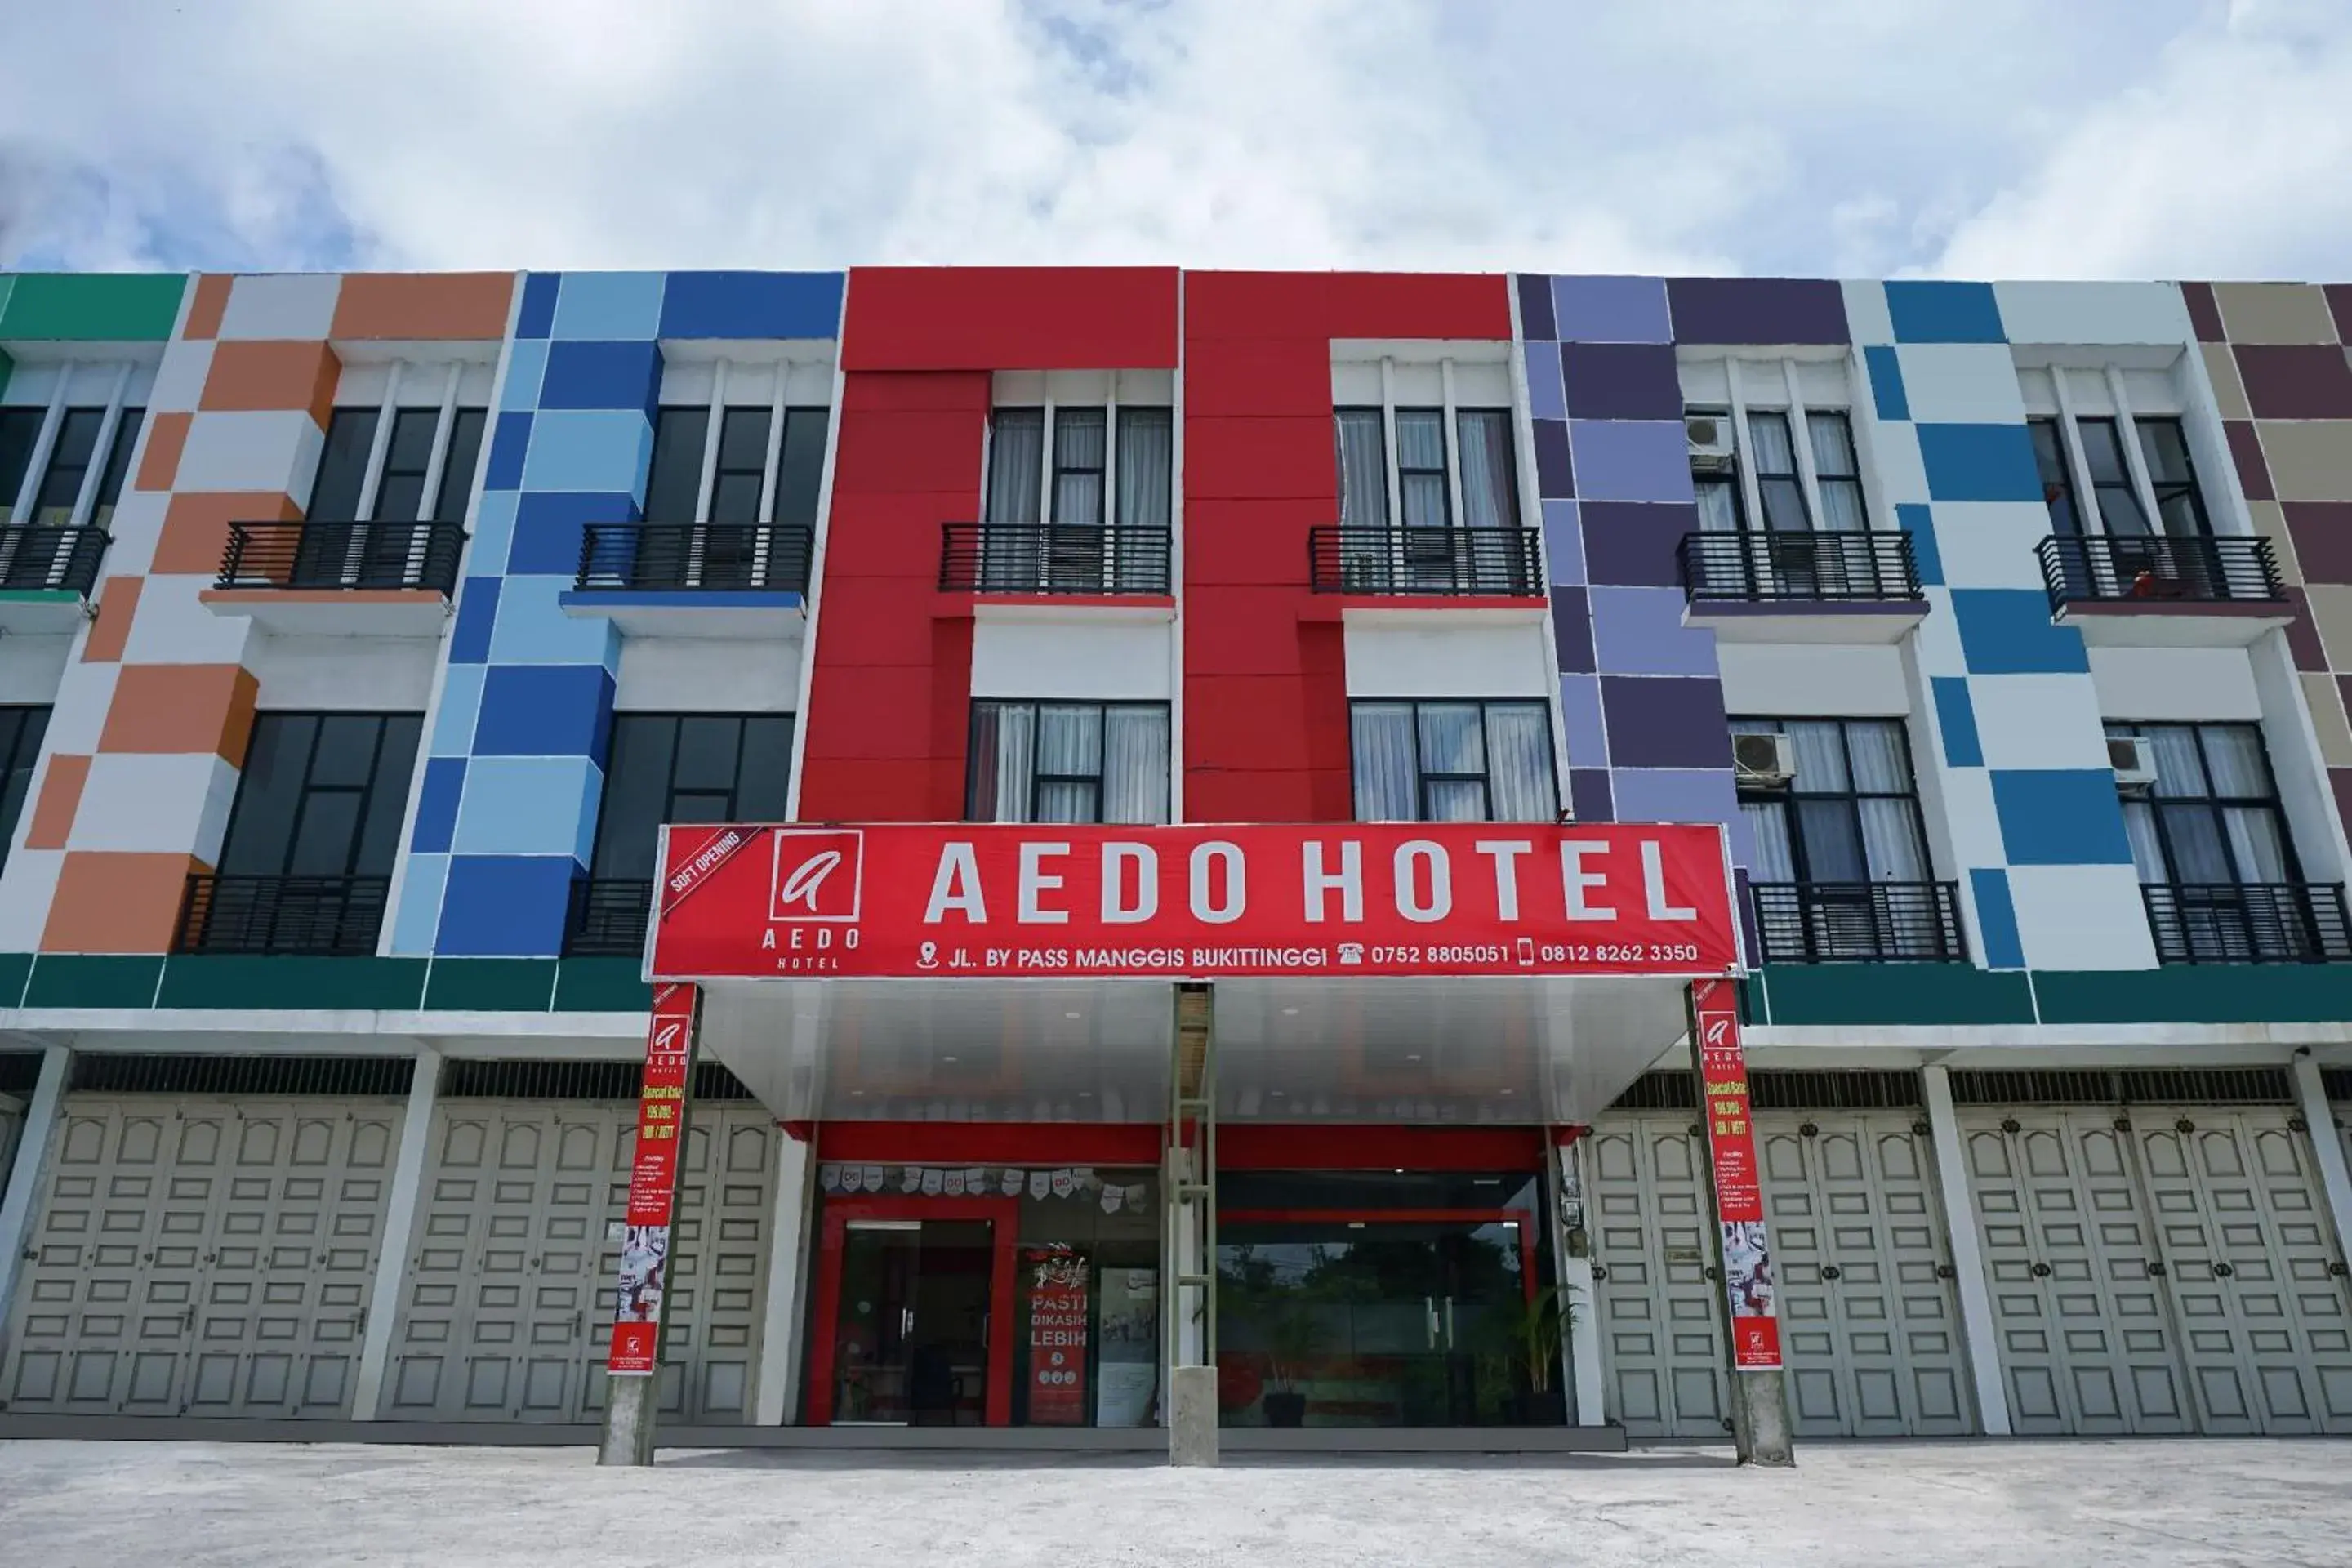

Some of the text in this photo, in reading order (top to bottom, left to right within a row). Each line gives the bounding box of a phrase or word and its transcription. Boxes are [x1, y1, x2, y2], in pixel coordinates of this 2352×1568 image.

[670, 831, 740, 892] SOFT OPENING
[924, 840, 1697, 924] AEDO HOTEL
[762, 928, 859, 949] AEDO
[777, 957, 839, 969] HOTEL
[949, 944, 1697, 968] JL. BY PASS MANGGIS BUKITTINGGI 0752 8805051 0812 8262 3350
[1031, 1294, 1088, 1311] PASTI
[1031, 1314, 1088, 1326] DIKASIH
[1030, 1330, 1088, 1347] LEBIH
